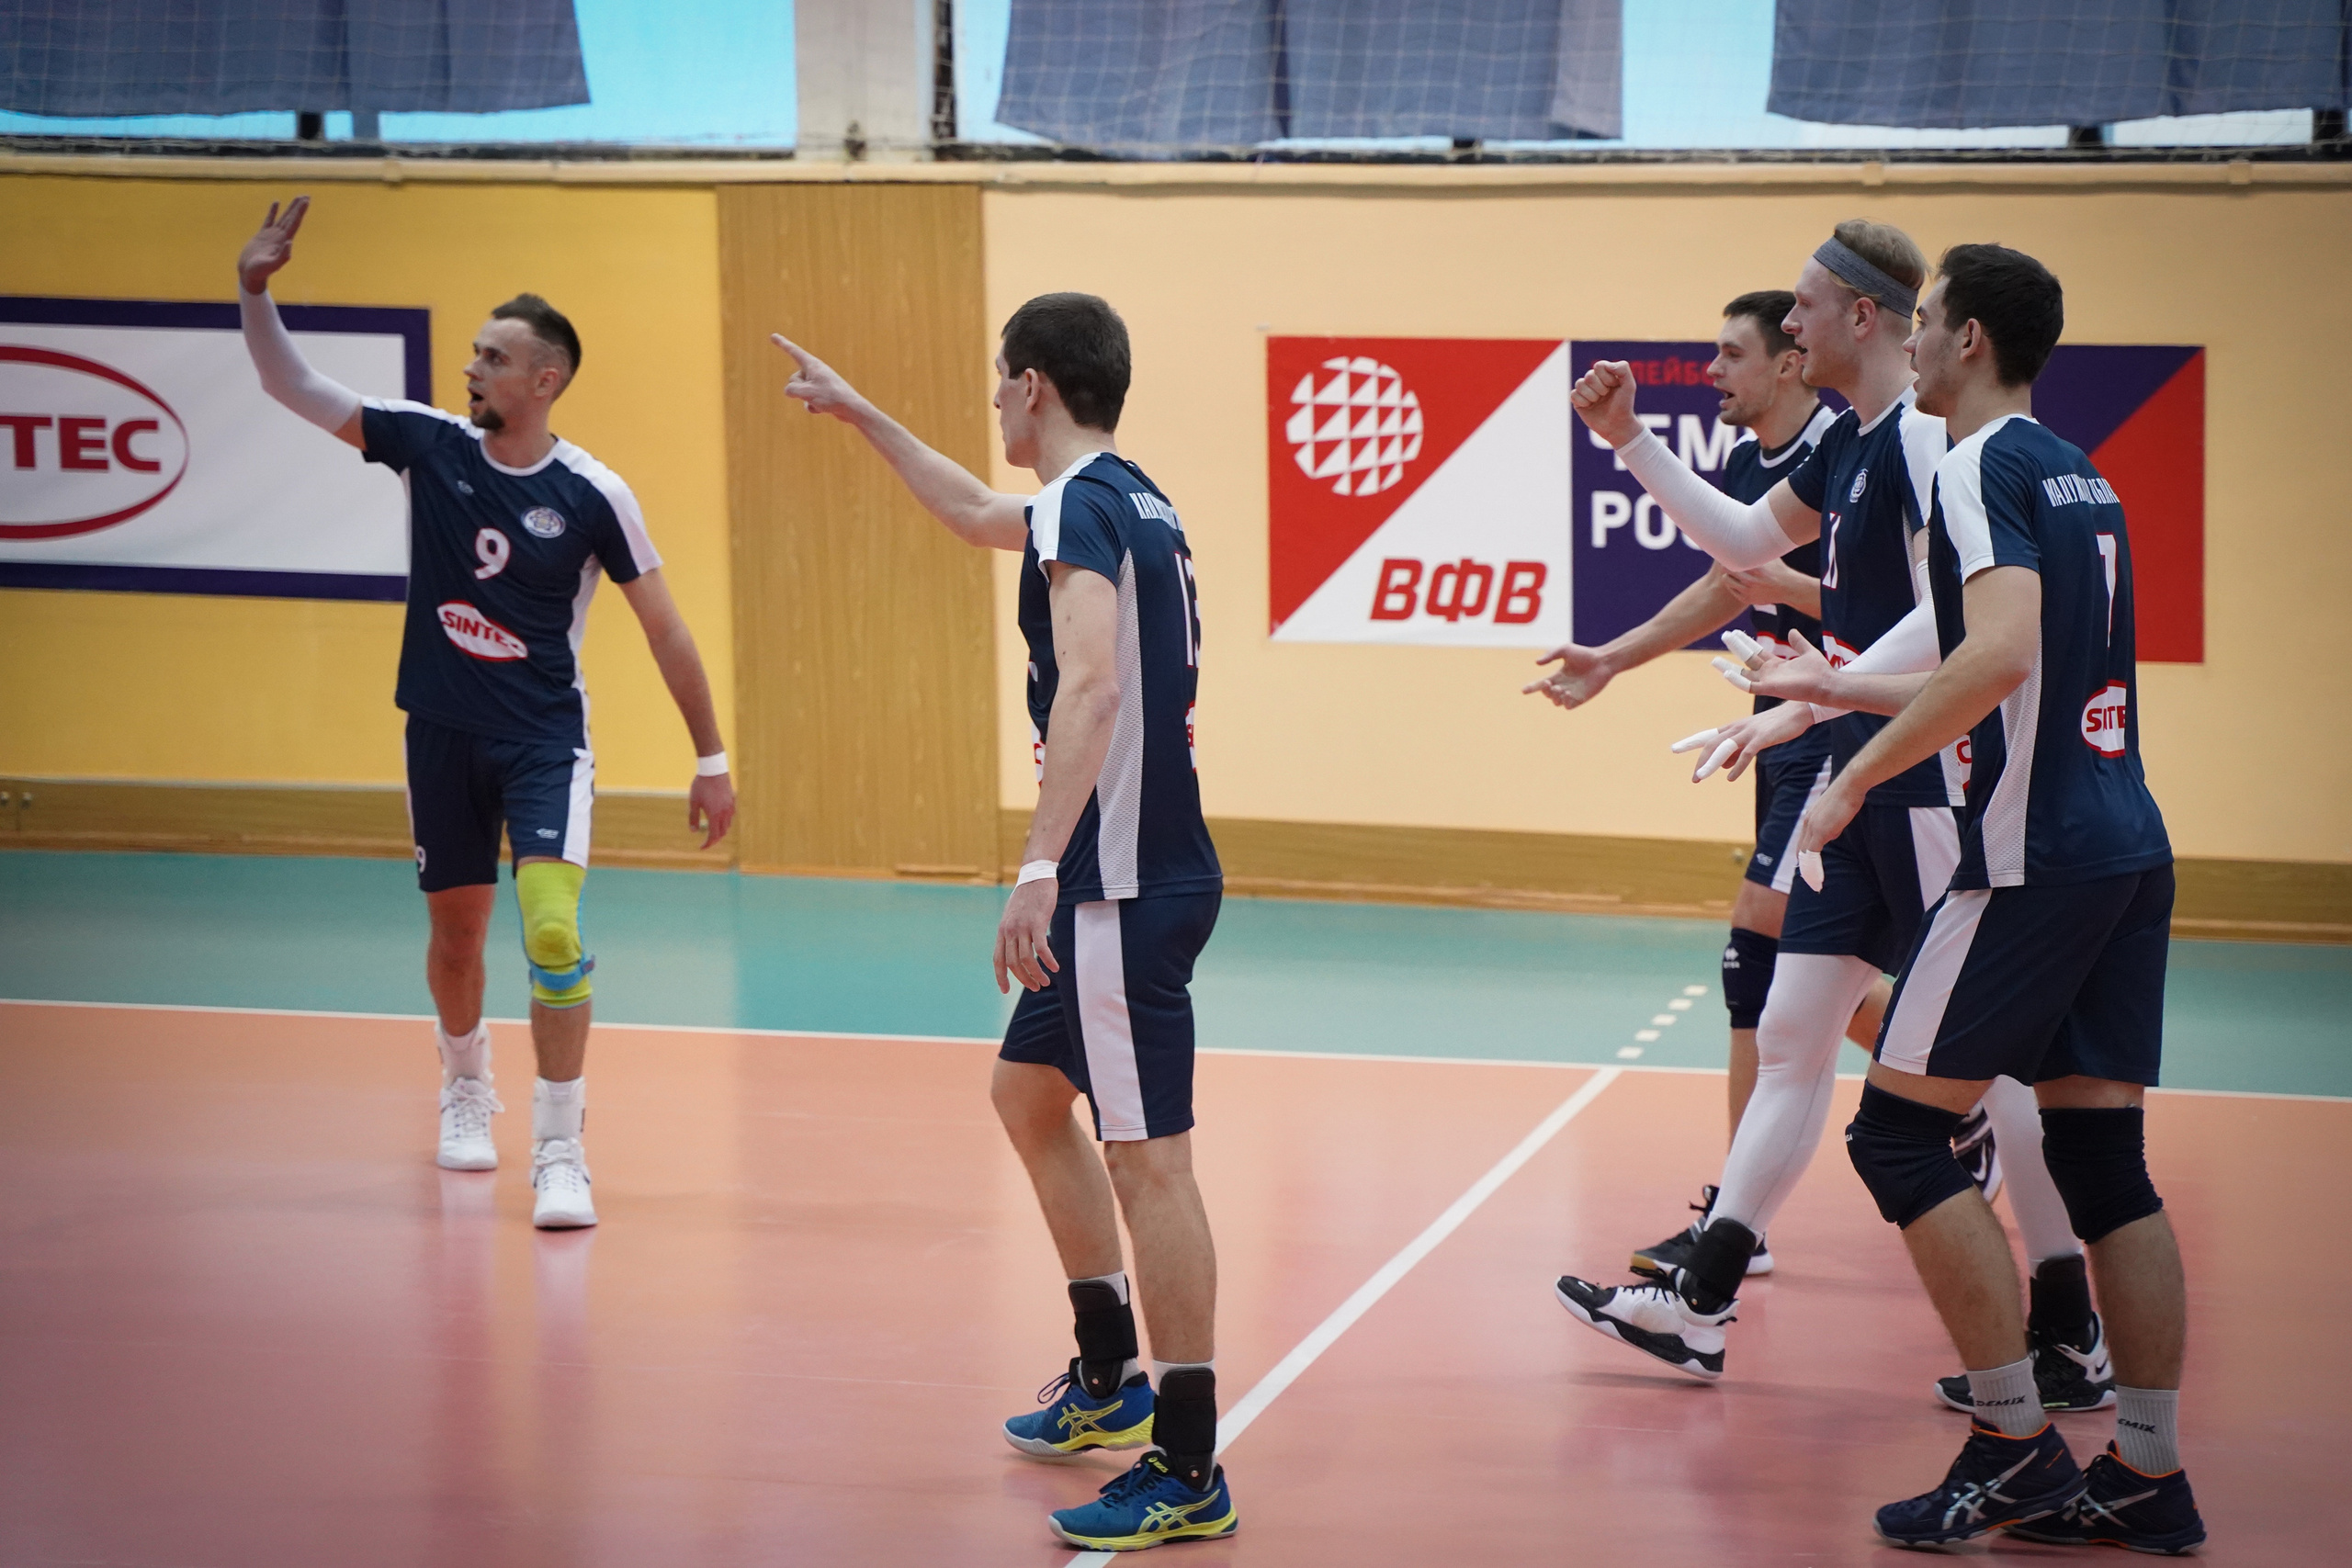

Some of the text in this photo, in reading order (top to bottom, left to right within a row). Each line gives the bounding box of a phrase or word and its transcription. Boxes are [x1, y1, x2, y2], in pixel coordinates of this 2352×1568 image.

[1590, 355, 1716, 386] ЛЕЙБО
[0, 414, 161, 473] TEC
[1590, 490, 1705, 550] РО
[474, 527, 510, 580] 9
[1370, 558, 1547, 624] ВФВ
[2096, 531, 2117, 649] 7
[1975, 1394, 2026, 1406] DEMIX
[2118, 1417, 2156, 1434] EMIX
